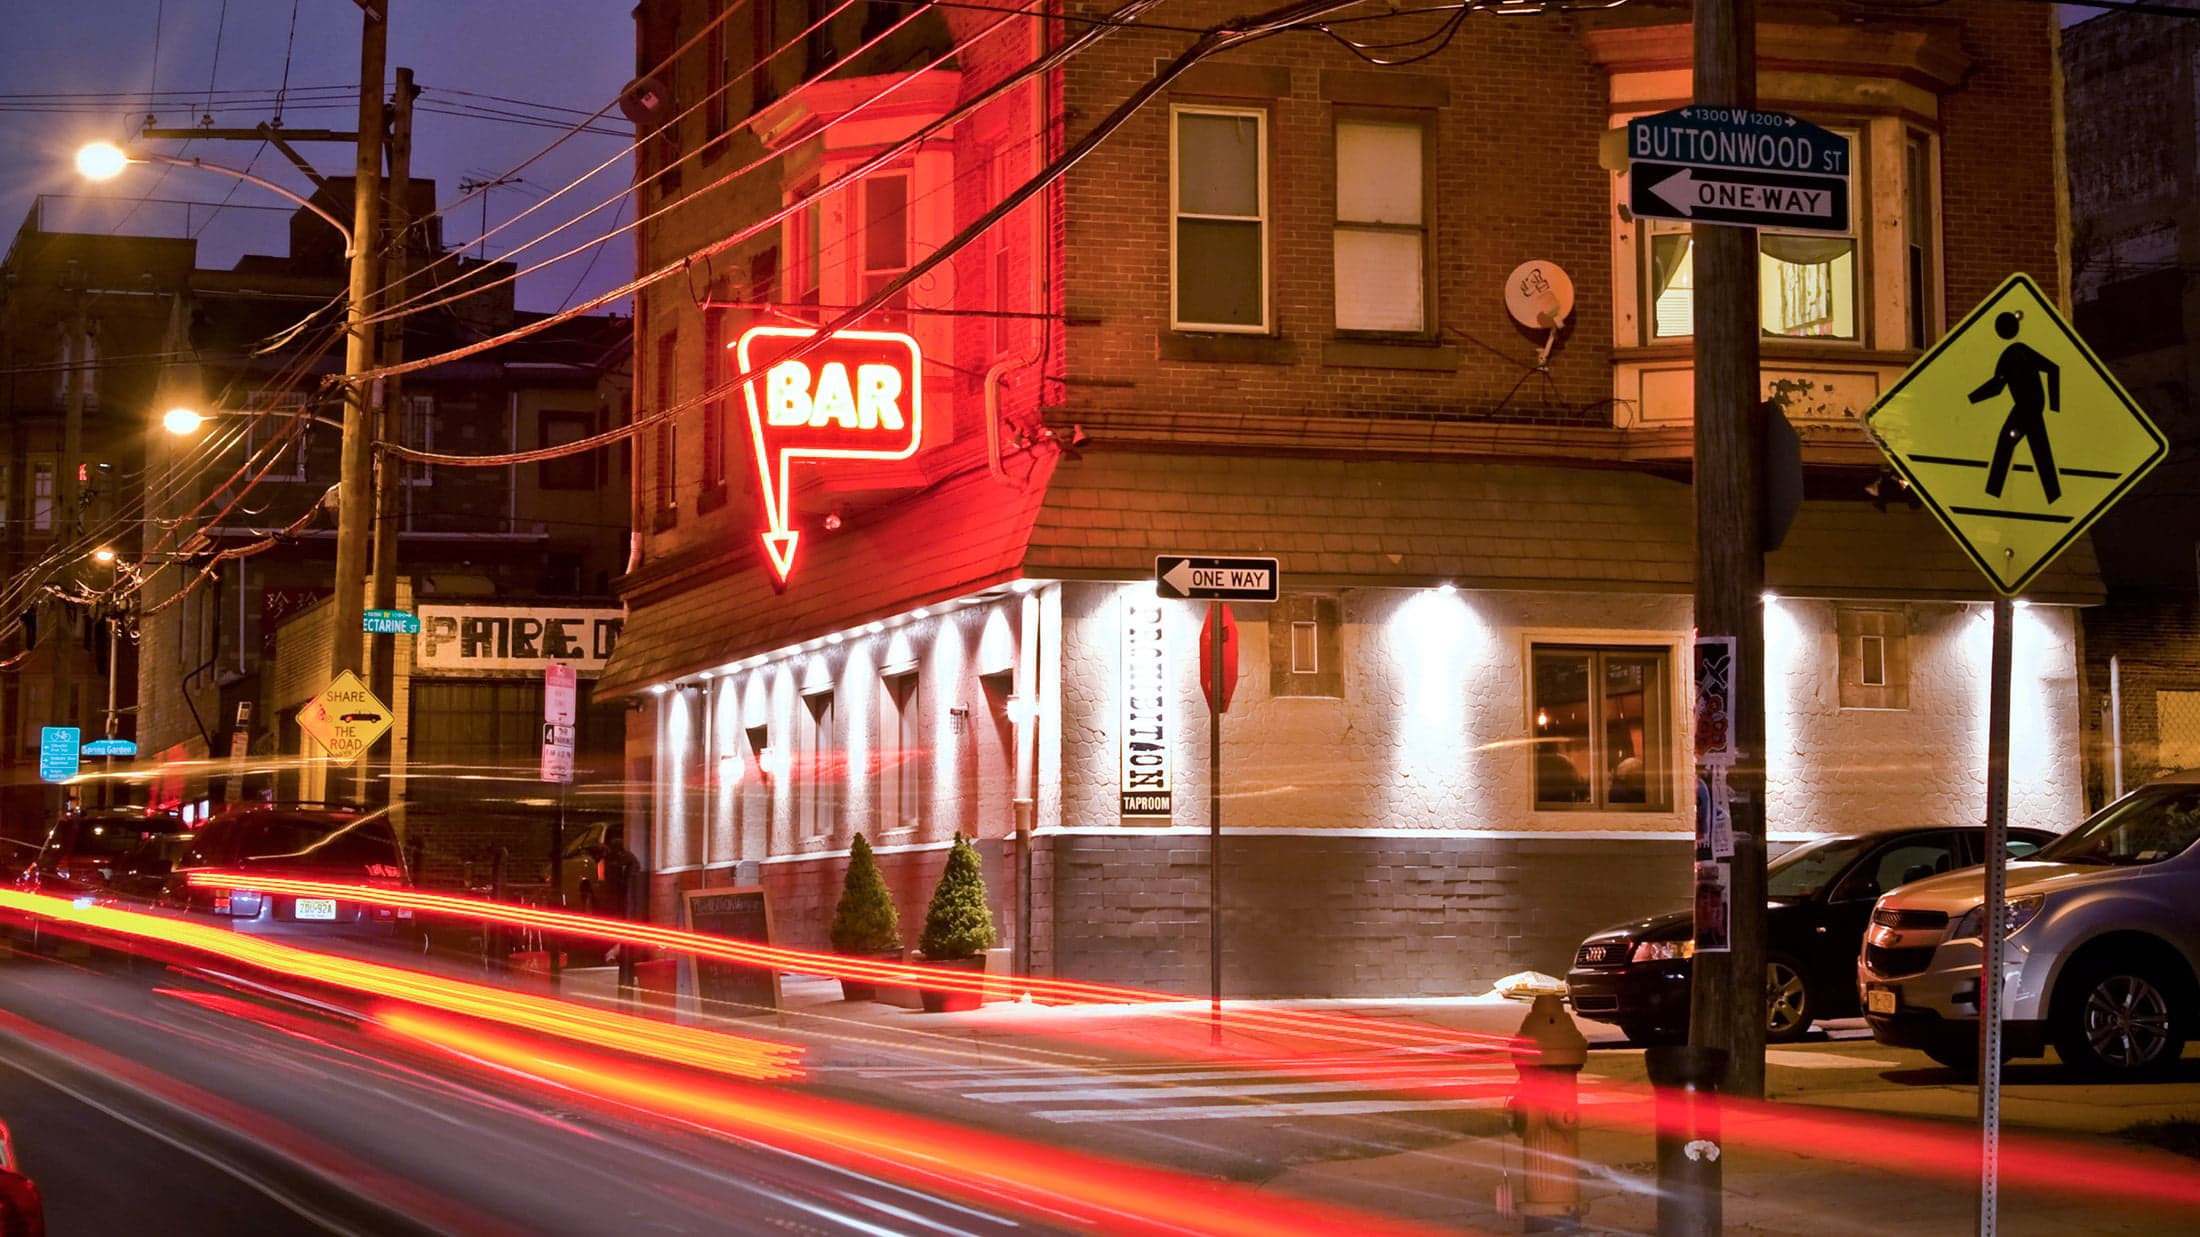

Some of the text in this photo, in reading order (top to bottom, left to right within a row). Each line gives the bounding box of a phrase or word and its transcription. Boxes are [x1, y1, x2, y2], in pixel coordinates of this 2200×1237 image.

[1696, 109, 1783, 127] 1300 W 1200
[1636, 124, 1842, 171] BUTTONWOOD ST
[1698, 183, 1822, 213] ONE WAY
[767, 359, 904, 430] BAR
[1192, 570, 1264, 588] ONE WAY
[327, 691, 366, 702] SHARE
[335, 726, 357, 738] THE
[107, 745, 132, 753] Garden
[330, 738, 362, 750] ROAD
[1124, 796, 1170, 810] TAPROOM
